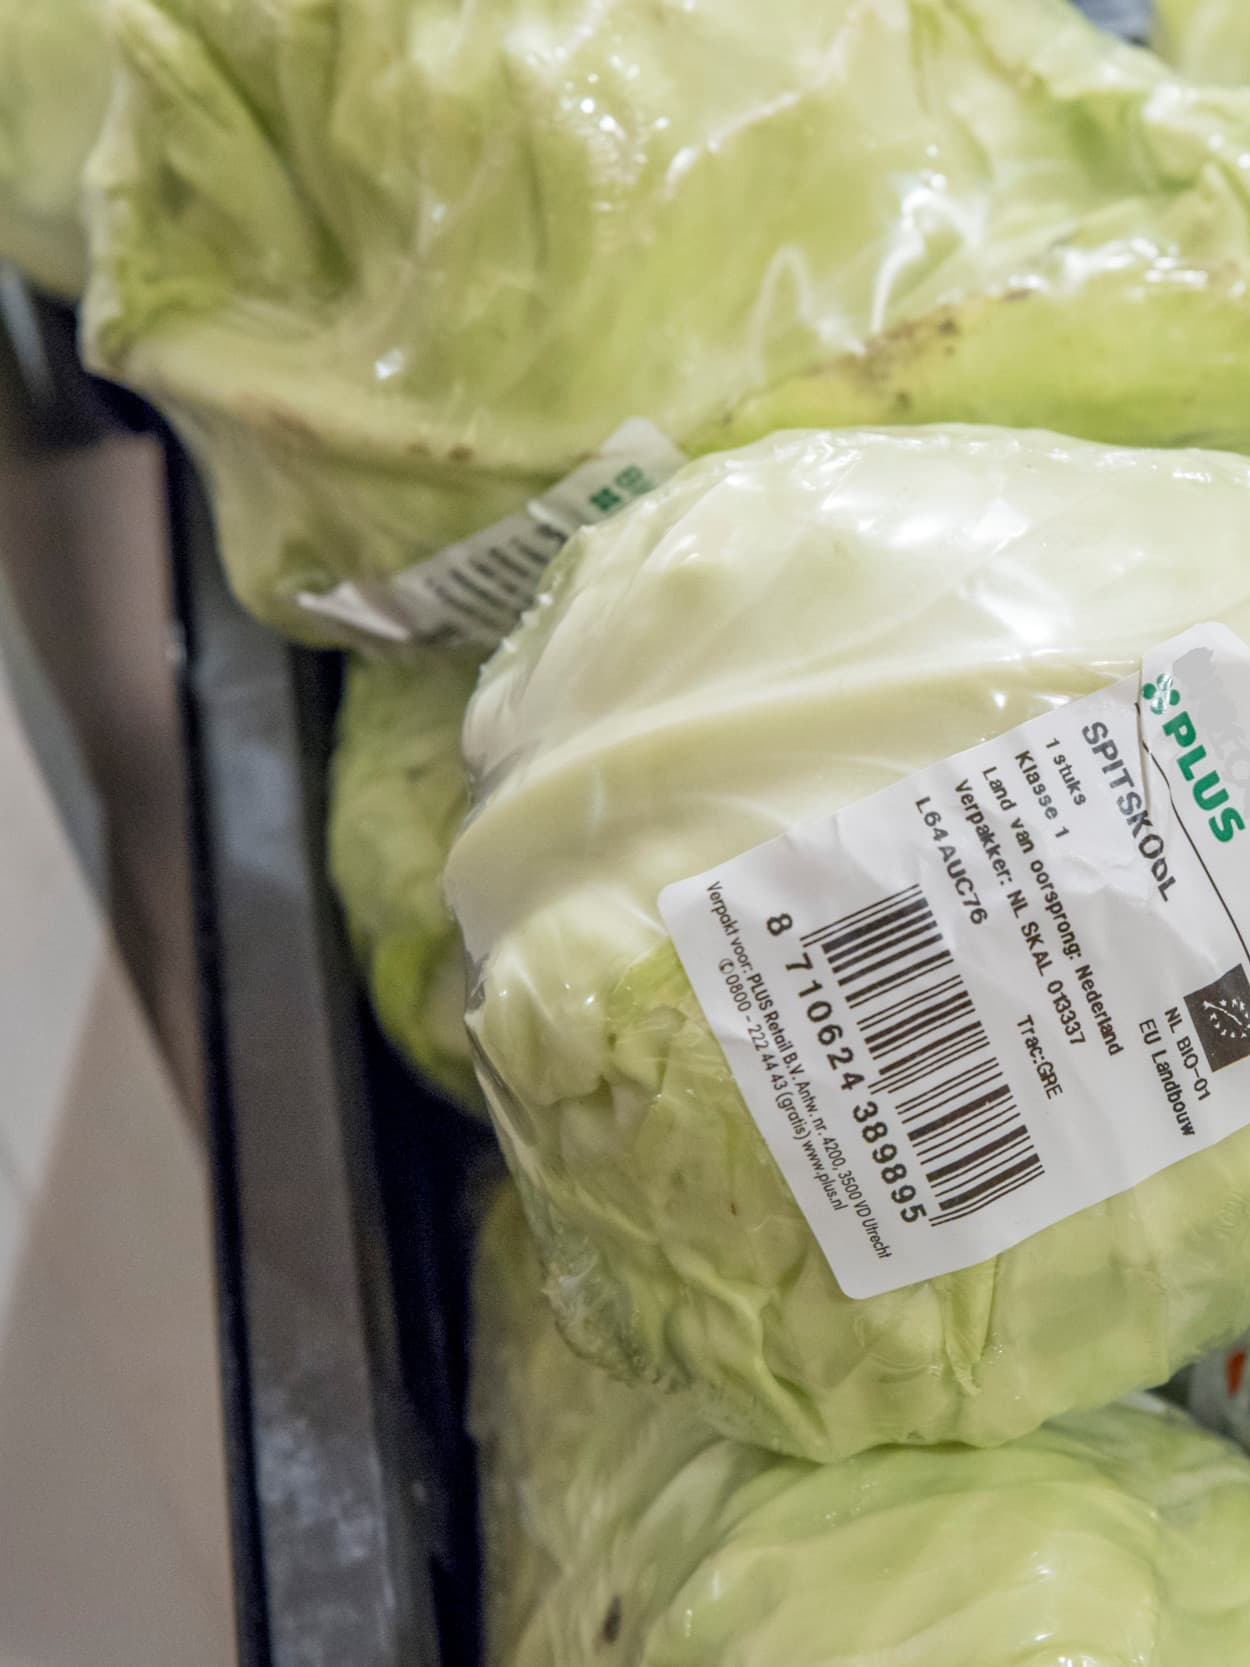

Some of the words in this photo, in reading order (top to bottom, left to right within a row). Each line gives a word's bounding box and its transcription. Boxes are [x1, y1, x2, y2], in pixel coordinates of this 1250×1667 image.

[1045, 738, 1061, 749] 1
[1014, 750, 1058, 820] Klasse
[1055, 826, 1070, 838] 1
[1052, 754, 1087, 806] stuks
[1162, 711, 1246, 843] PLUS
[706, 880, 740, 937] Verpakt
[954, 778, 1013, 886] Verpakker:
[1006, 889, 1029, 919] NL
[1020, 921, 1053, 977] SKAL
[1047, 979, 1087, 1045] 013337
[982, 766, 1017, 811] Land
[1010, 817, 1035, 855] van
[1030, 859, 1082, 961] oorsprong:
[1074, 964, 1125, 1057] Nederland
[730, 936, 754, 974] voor:
[746, 972, 774, 1011] PLUS
[747, 1023, 770, 1052] 222
[763, 1010, 794, 1053] Retail
[761, 1053, 779, 1072] 44
[766, 913, 793, 937] 8
[785, 951, 865, 1091] 710624
[852, 1100, 928, 1224] 389895
[782, 1051, 805, 1081] B.V.
[1016, 1014, 1063, 1100] Trac:GRE
[1164, 1006, 1183, 1034] NL
[1176, 1035, 1211, 1101] BIO-01
[770, 1073, 789, 1091] 43
[1138, 1018, 1162, 1046] EU
[1151, 1049, 1196, 1137] Landbouw
[775, 1091, 812, 1141] (gratis)
[794, 1081, 819, 1117] Antw.
[811, 1117, 828, 1136] nr.
[802, 1139, 849, 1211] www.plus.nl
[822, 1137, 847, 1171] 4200,
[837, 1170, 863, 1201] 3500
[853, 1199, 872, 1218] VD
[861, 1217, 893, 1259] Utrecht
